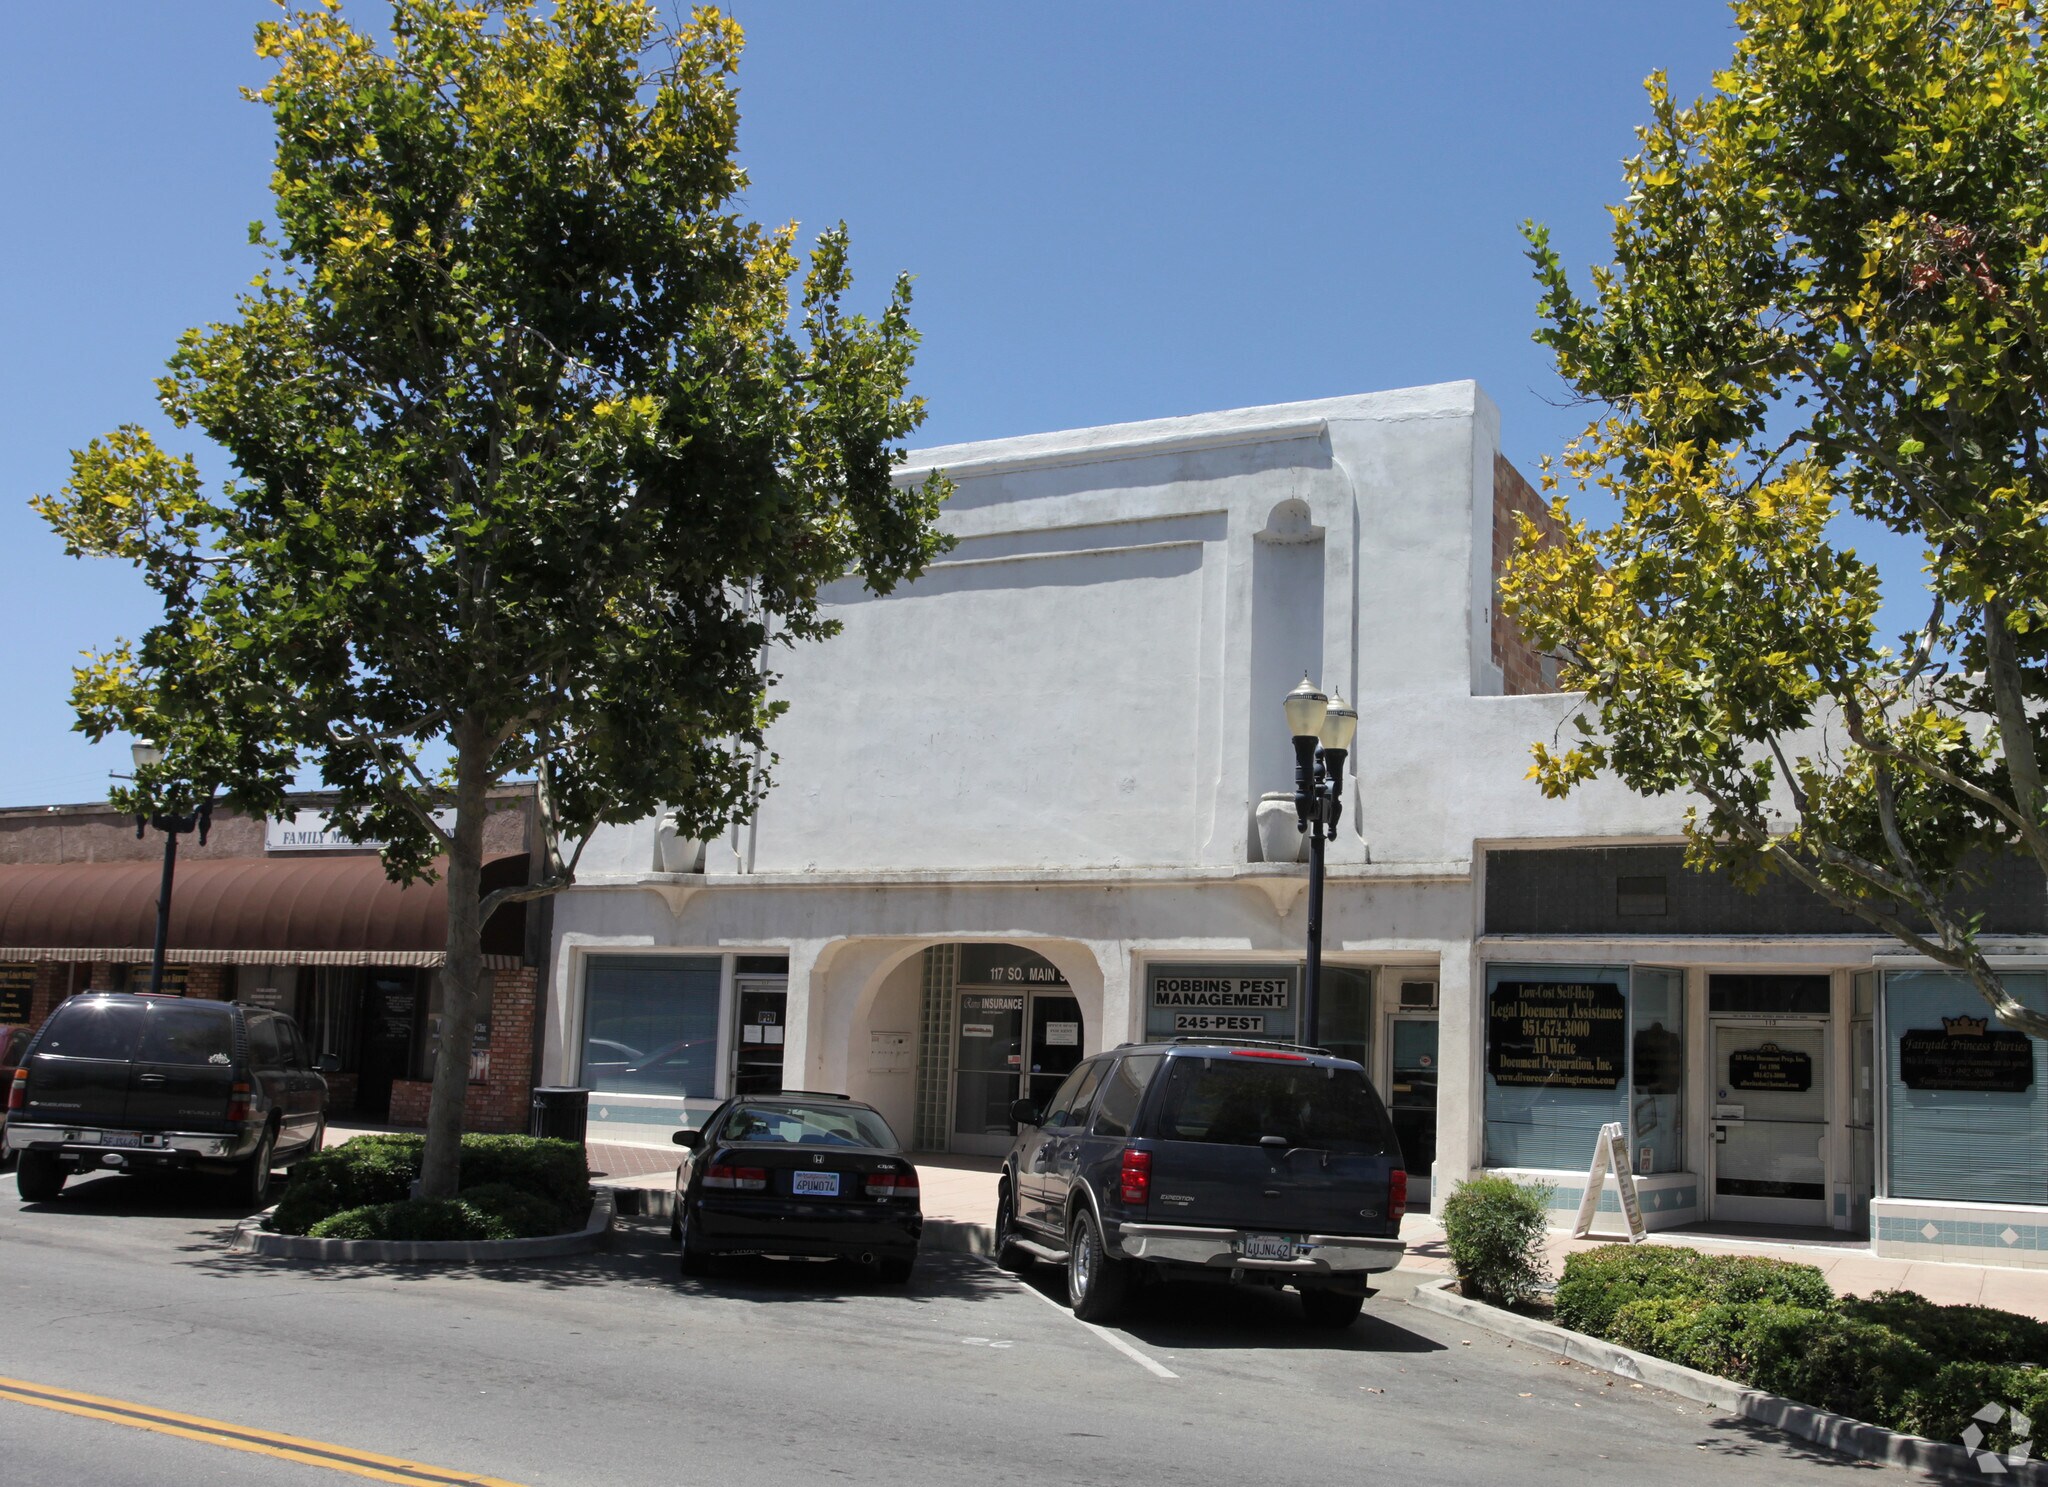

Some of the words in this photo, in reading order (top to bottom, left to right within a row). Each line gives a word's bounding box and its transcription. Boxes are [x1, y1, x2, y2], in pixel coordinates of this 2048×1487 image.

[283, 831, 325, 845] FAMILY
[990, 967, 1004, 980] 117
[1007, 967, 1025, 981] SO.
[1029, 968, 1055, 981] MAIN
[1156, 979, 1231, 993] ROBBINS
[1240, 980, 1286, 993] PEST
[1519, 984, 1555, 999] Low-Cost
[1556, 984, 1595, 1001] Self-Help
[981, 998, 1023, 1010] INSURANCE
[1156, 992, 1286, 1007] MANAGEMENT
[1491, 1000, 1518, 1021] Legal
[1520, 1001, 1569, 1019] Document
[1571, 1002, 1623, 1020] Assistance
[1177, 1016, 1262, 1030] 245-PEST
[1522, 1019, 1591, 1037] 951-674-3000
[1532, 1038, 1546, 1054] All
[1549, 1038, 1577, 1055] Write
[1952, 1040, 1991, 1051] Princess
[1993, 1040, 2028, 1052] Parties
[1500, 1054, 1540, 1069] Document
[1596, 1057, 1612, 1071] Inc.
[796, 1180, 835, 1192] 6PUW074
[1160, 1194, 1196, 1202] EXPEDITION
[1247, 1243, 1289, 1257] 4UJN462
